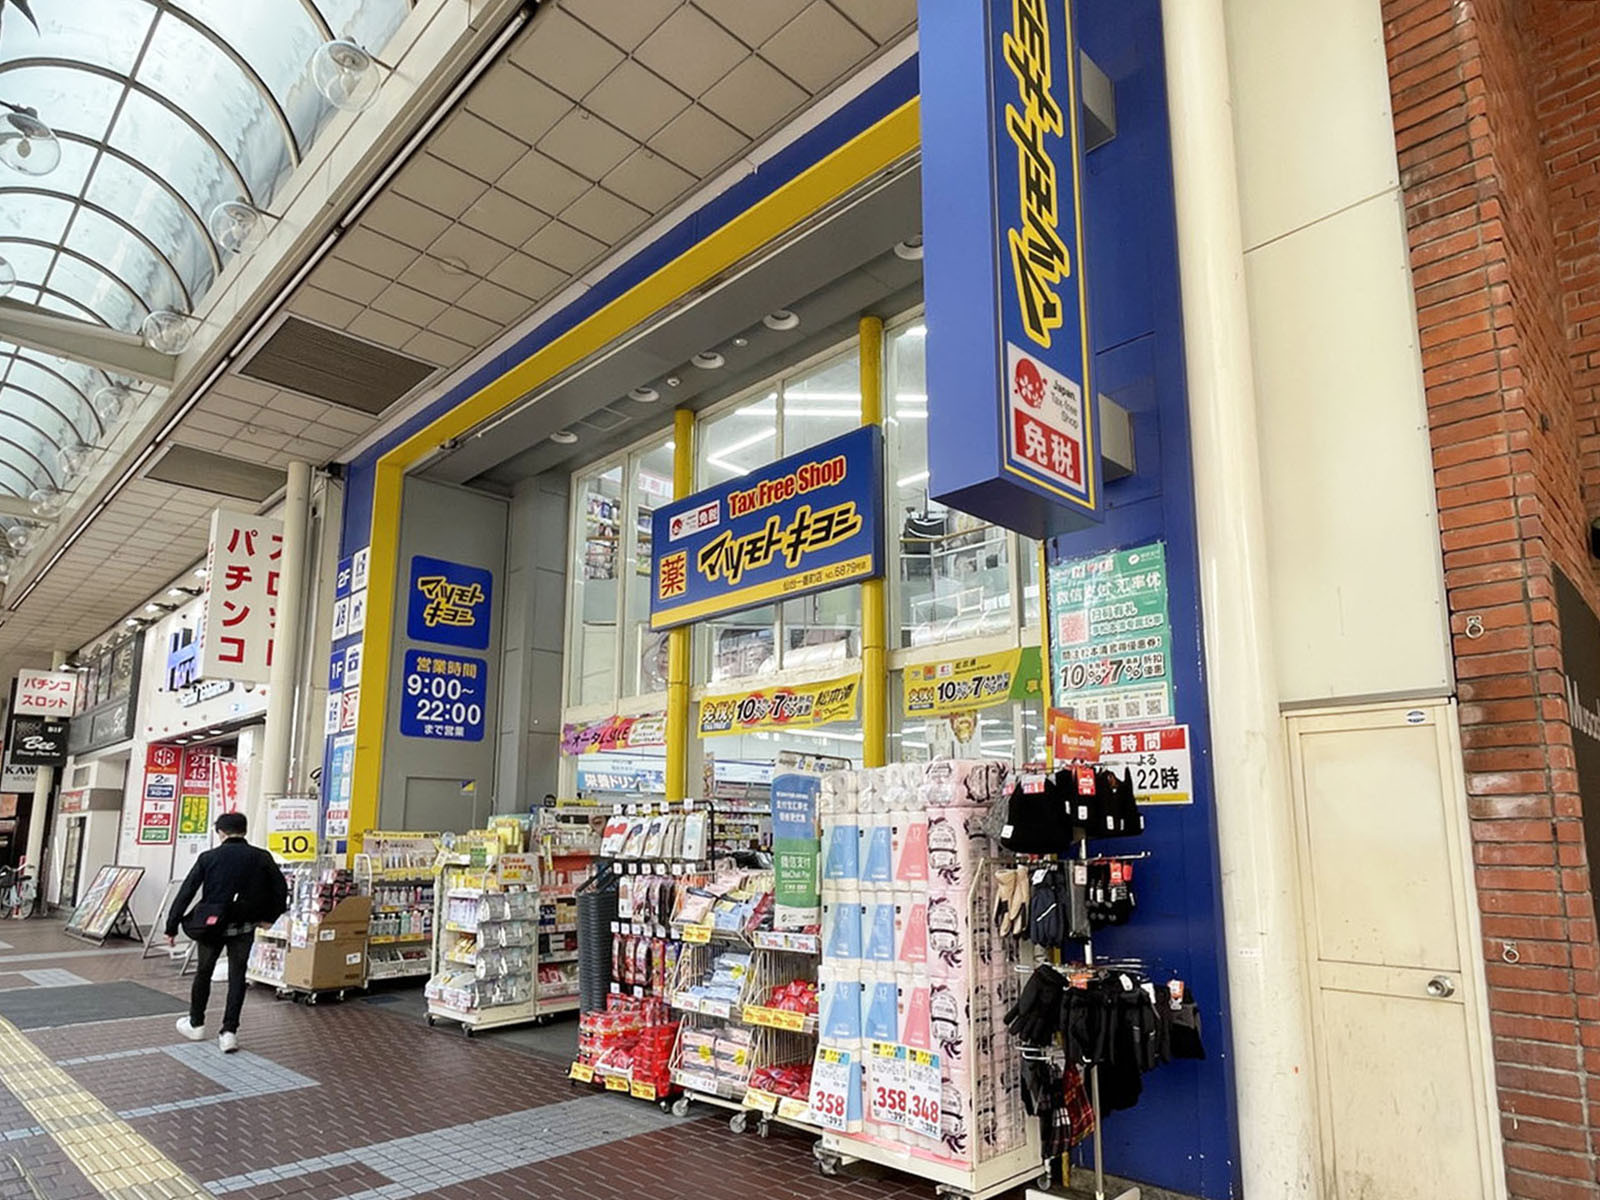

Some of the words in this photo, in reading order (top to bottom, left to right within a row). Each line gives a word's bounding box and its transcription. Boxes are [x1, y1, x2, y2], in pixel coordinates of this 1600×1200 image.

[1023, 420, 1074, 478] 免税
[728, 492, 758, 518] Tax
[757, 476, 796, 504] Free
[797, 455, 847, 494] Shop
[698, 501, 862, 585] マツモトキヨシ
[337, 569, 350, 588] 2F
[660, 554, 685, 597] 薬
[218, 528, 258, 664] パチンコ
[417, 576, 484, 605] マツモト
[424, 601, 476, 627] キヨシ
[331, 661, 344, 680] 1F
[416, 657, 477, 678] 営業時間
[24, 677, 71, 692] パチンコ
[22, 694, 68, 708] スロット
[416, 699, 481, 724] 22:00
[22, 735, 57, 750] Bee
[424, 724, 465, 737] まで営業
[1137, 754, 1158, 766] よる
[1137, 767, 1180, 790] 22時
[282, 835, 309, 854] 10
[815, 1091, 846, 1116] 358
[876, 1086, 907, 1112] 358
[912, 1094, 939, 1123] 348
